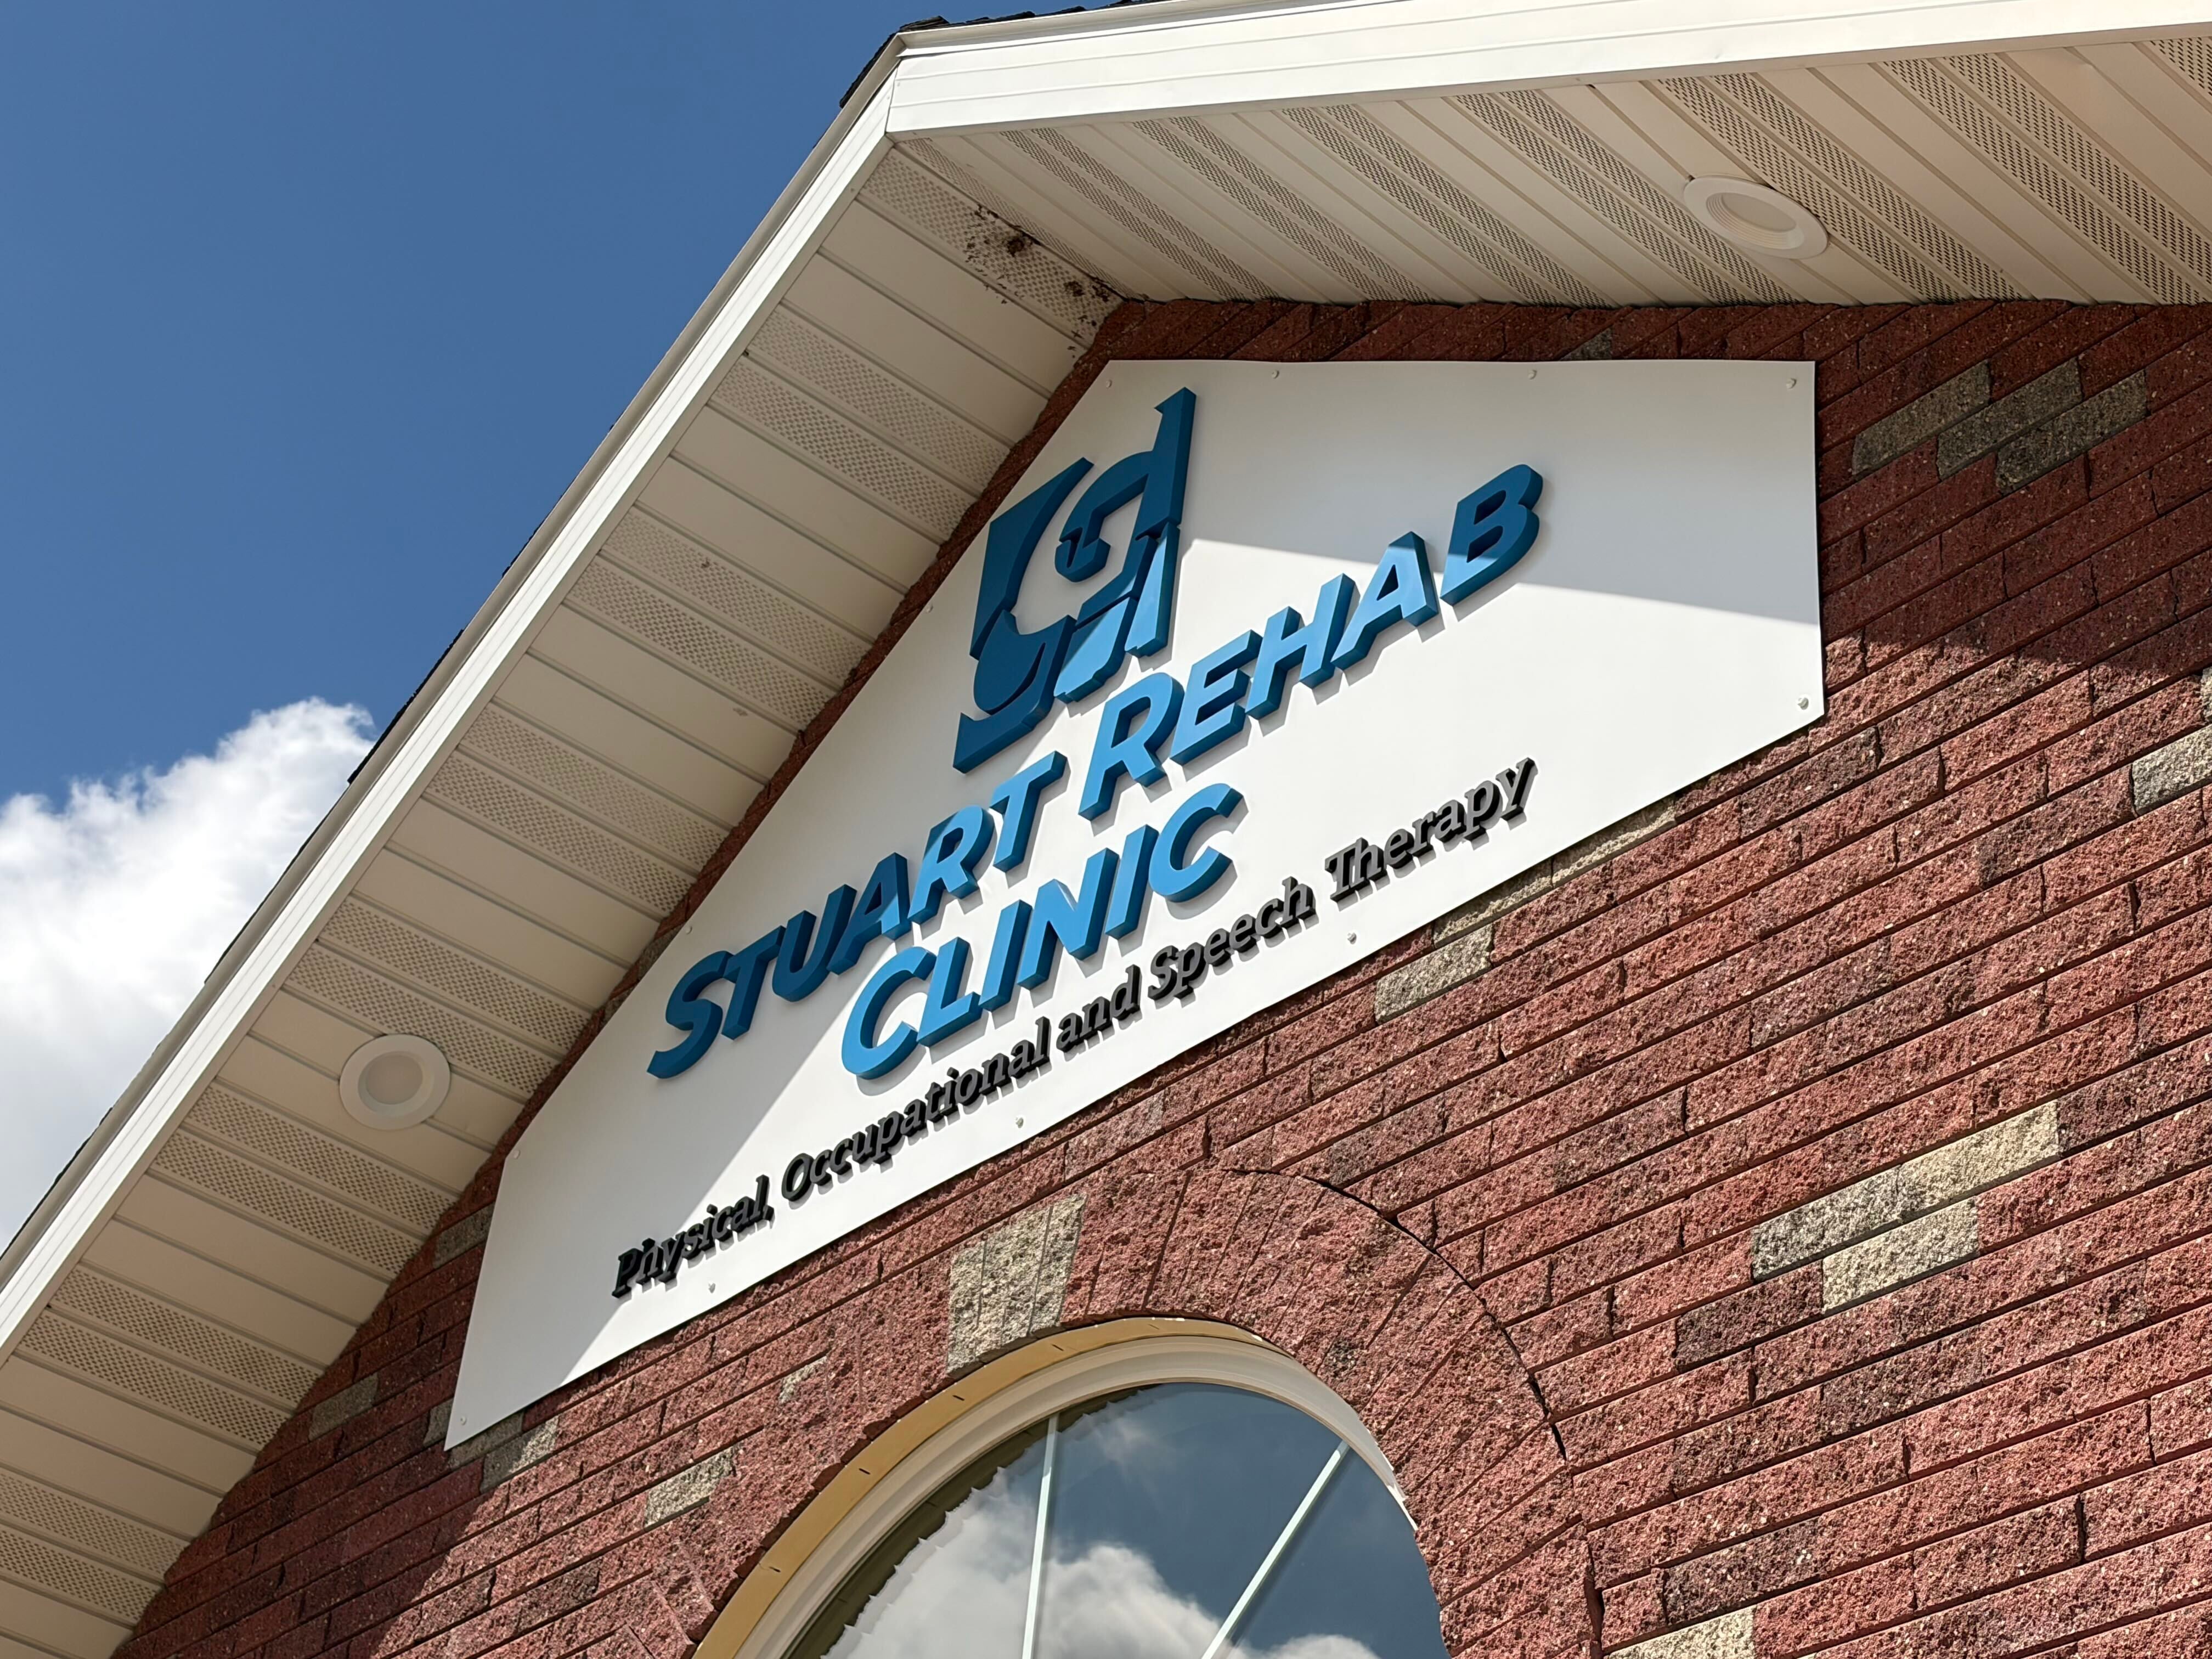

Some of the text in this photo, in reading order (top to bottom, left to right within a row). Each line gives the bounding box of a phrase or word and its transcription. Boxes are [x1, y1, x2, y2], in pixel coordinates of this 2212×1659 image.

[612, 757, 1538, 1298] Physical, Occupational and Speech Therapy
[646, 464, 1543, 1079] STUART REHAB
[841, 783, 1244, 1080] CLINIC
